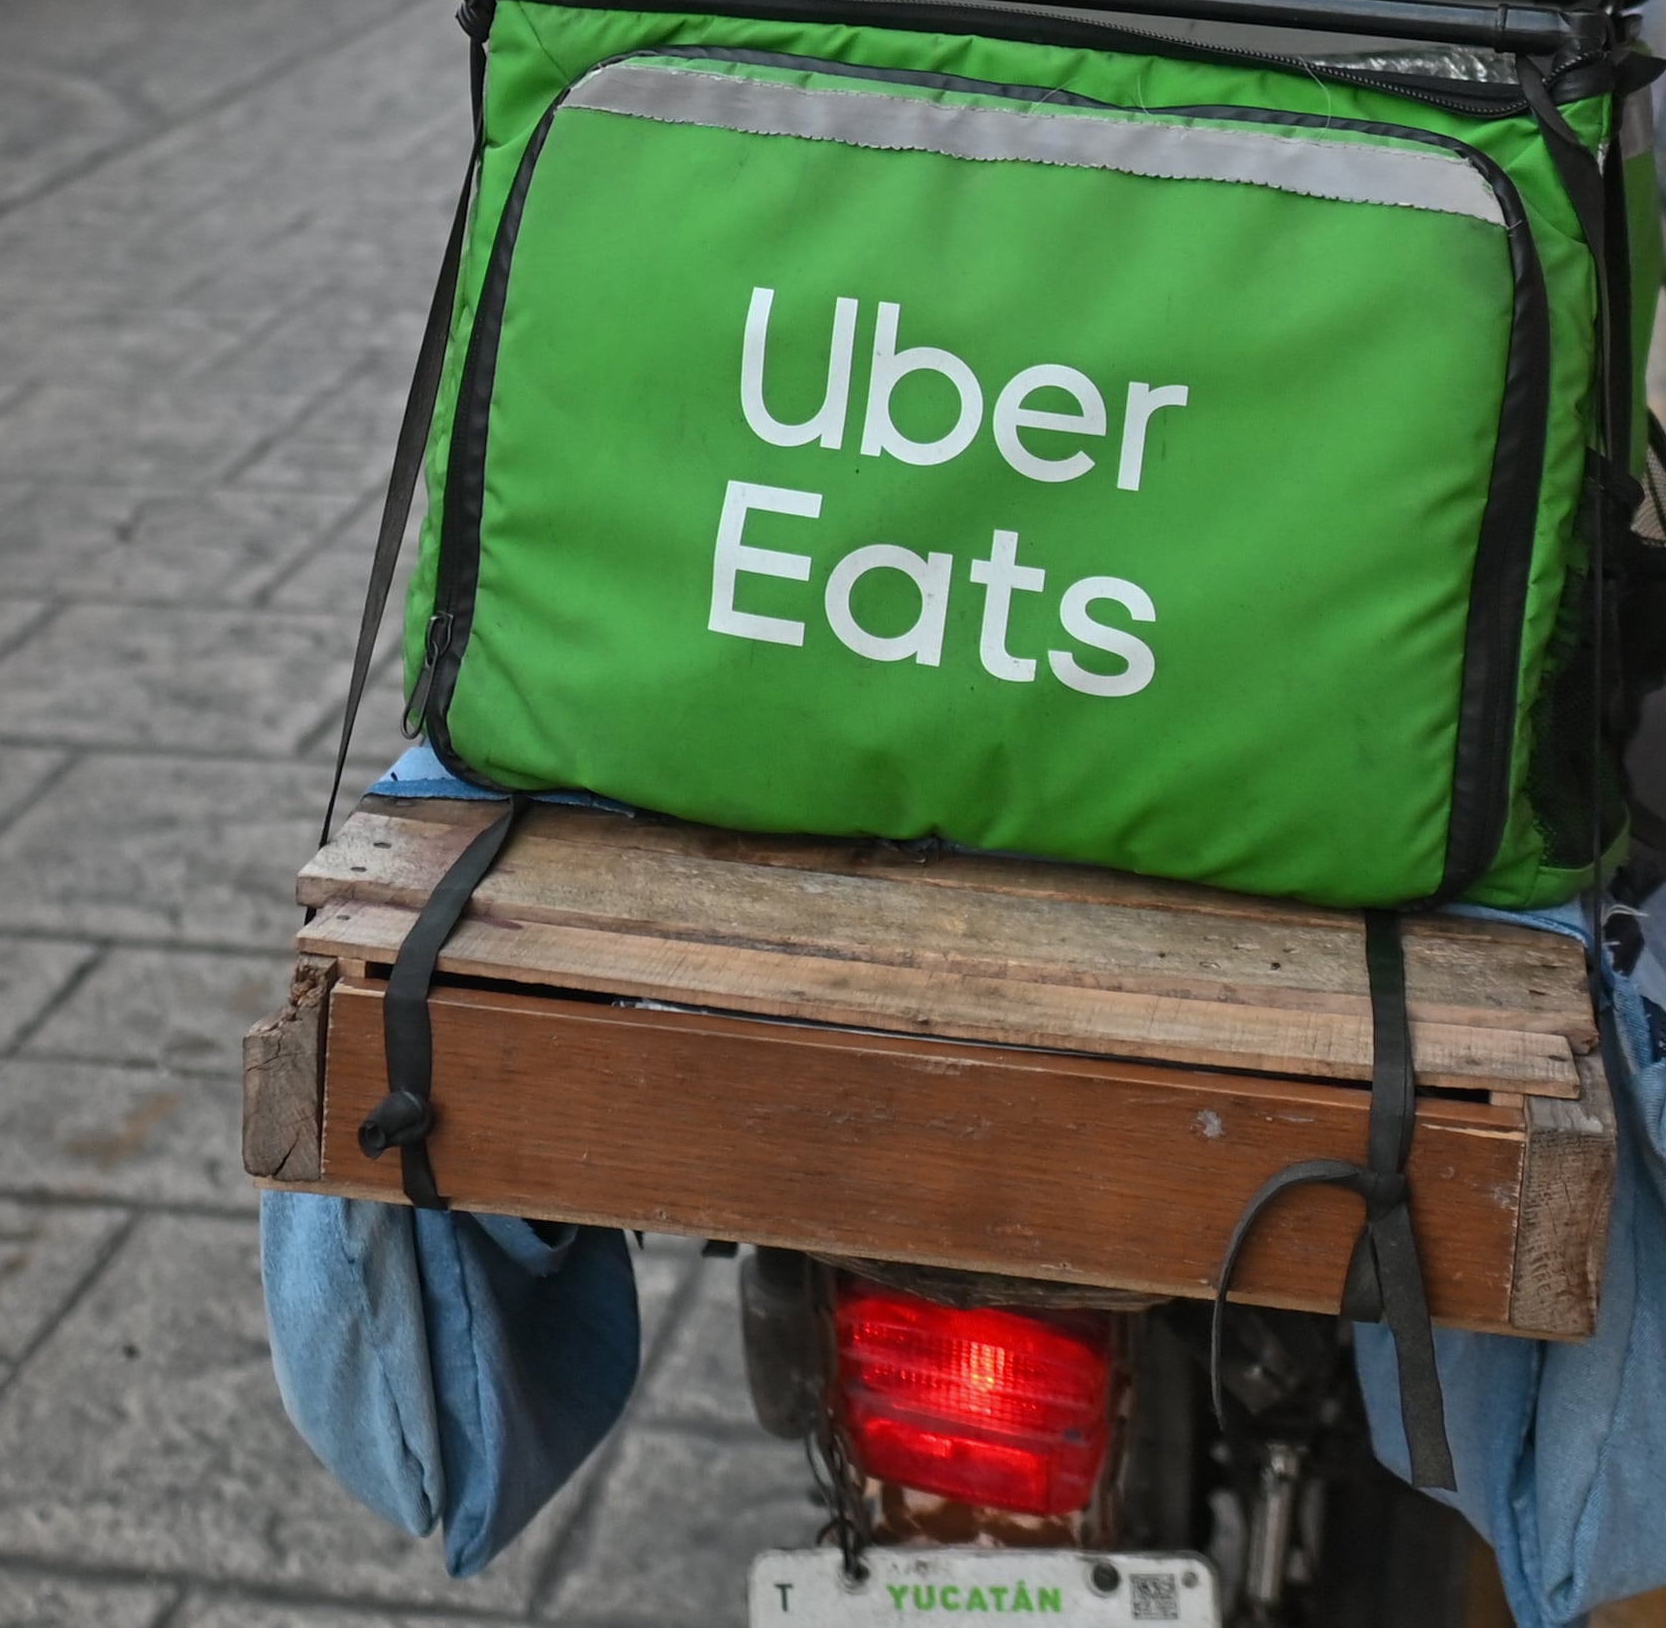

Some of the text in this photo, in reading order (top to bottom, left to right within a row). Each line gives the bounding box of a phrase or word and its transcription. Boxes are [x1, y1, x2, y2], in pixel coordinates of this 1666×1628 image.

[740, 286, 1189, 491] Uber
[708, 480, 1156, 697] Eats
[774, 1580, 1062, 1613] T YUCATÁN
